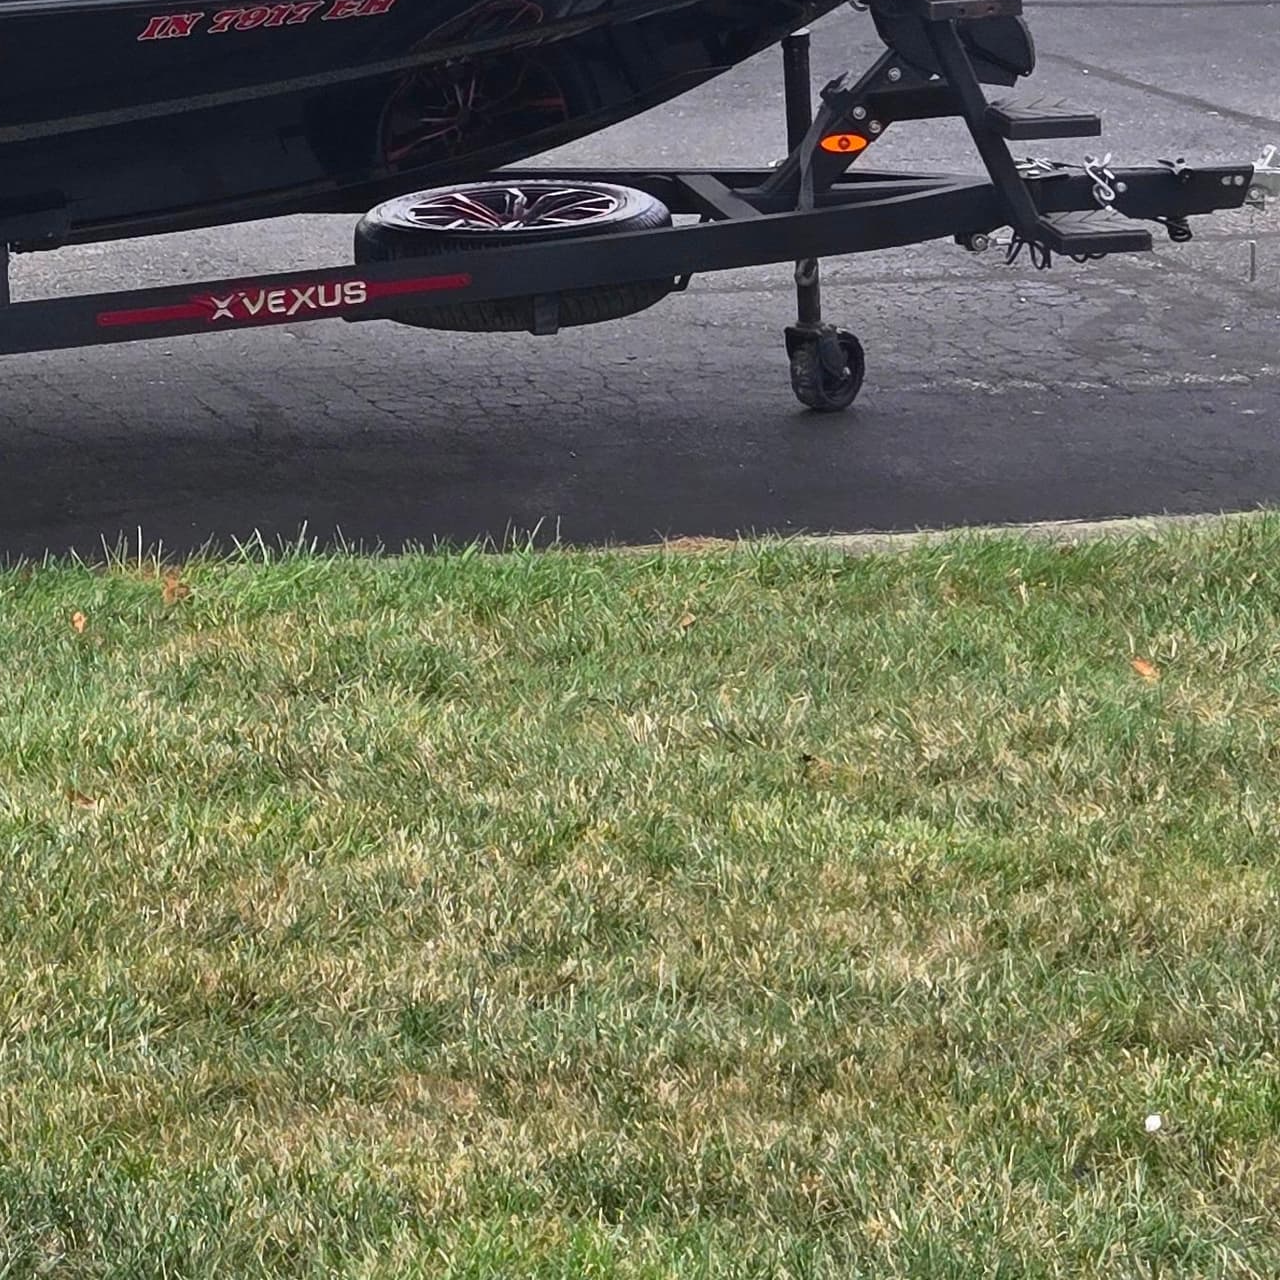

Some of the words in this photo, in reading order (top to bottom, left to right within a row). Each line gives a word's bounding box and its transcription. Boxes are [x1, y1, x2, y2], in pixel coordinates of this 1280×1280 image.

[137, 12, 205, 41] IN
[207, 0, 326, 34] 7917
[239, 280, 367, 316] VEXUS
